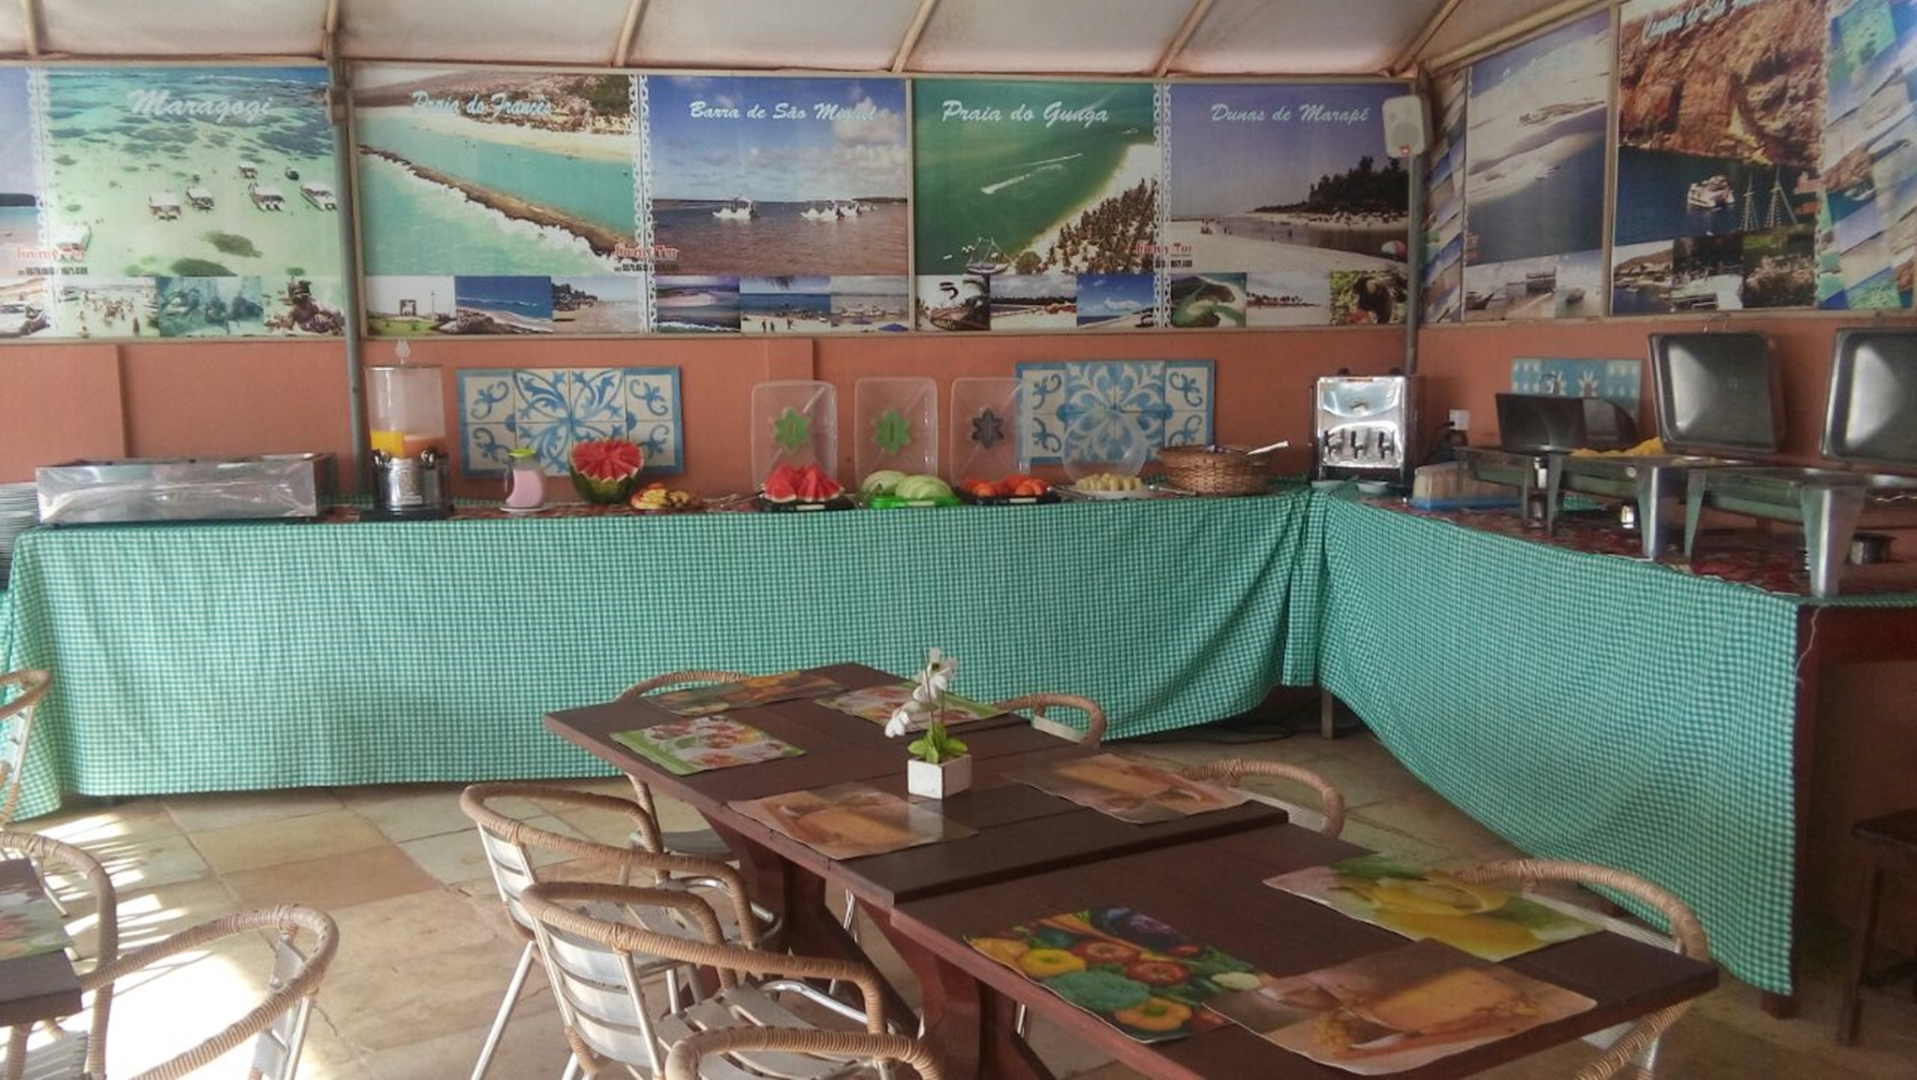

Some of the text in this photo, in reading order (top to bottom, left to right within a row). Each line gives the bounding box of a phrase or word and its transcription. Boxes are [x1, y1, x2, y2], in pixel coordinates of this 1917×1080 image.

[127, 88, 273, 123] Maragogi
[466, 93, 485, 114] do
[689, 101, 740, 119] Barra
[746, 104, 767, 119] de
[772, 102, 807, 120] São
[942, 99, 1110, 129] Praia do Gunga
[1211, 103, 1371, 126] Dunas de Marapé
